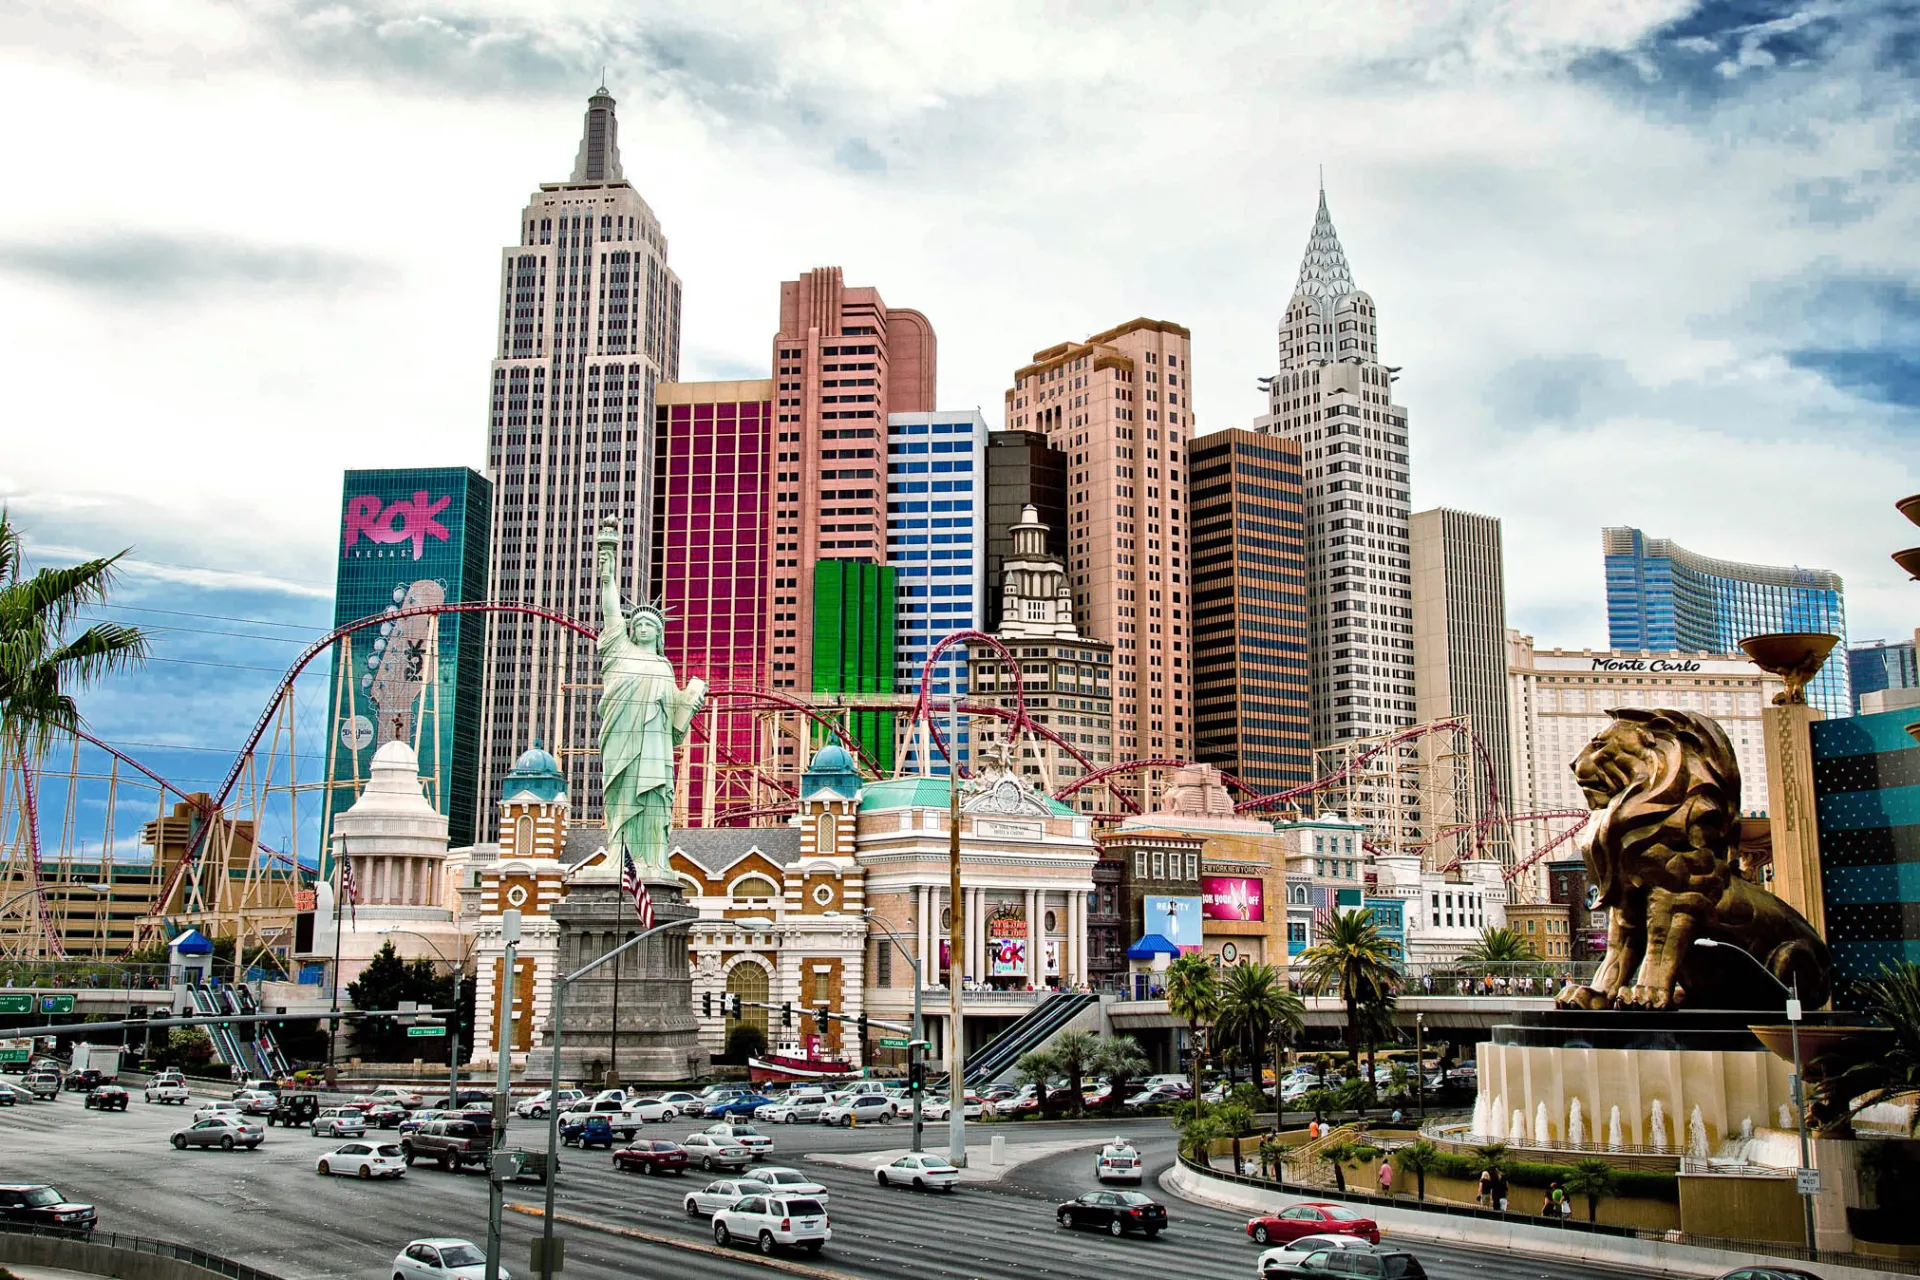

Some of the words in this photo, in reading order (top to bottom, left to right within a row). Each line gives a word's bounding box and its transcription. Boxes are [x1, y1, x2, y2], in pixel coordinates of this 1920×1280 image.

[355, 549, 406, 558] VEGAS
[1591, 658, 1647, 671] Monte
[1649, 659, 1701, 672] Carlo
[1228, 865, 1241, 873] NEW
[46, 1000, 55, 1008] 15
